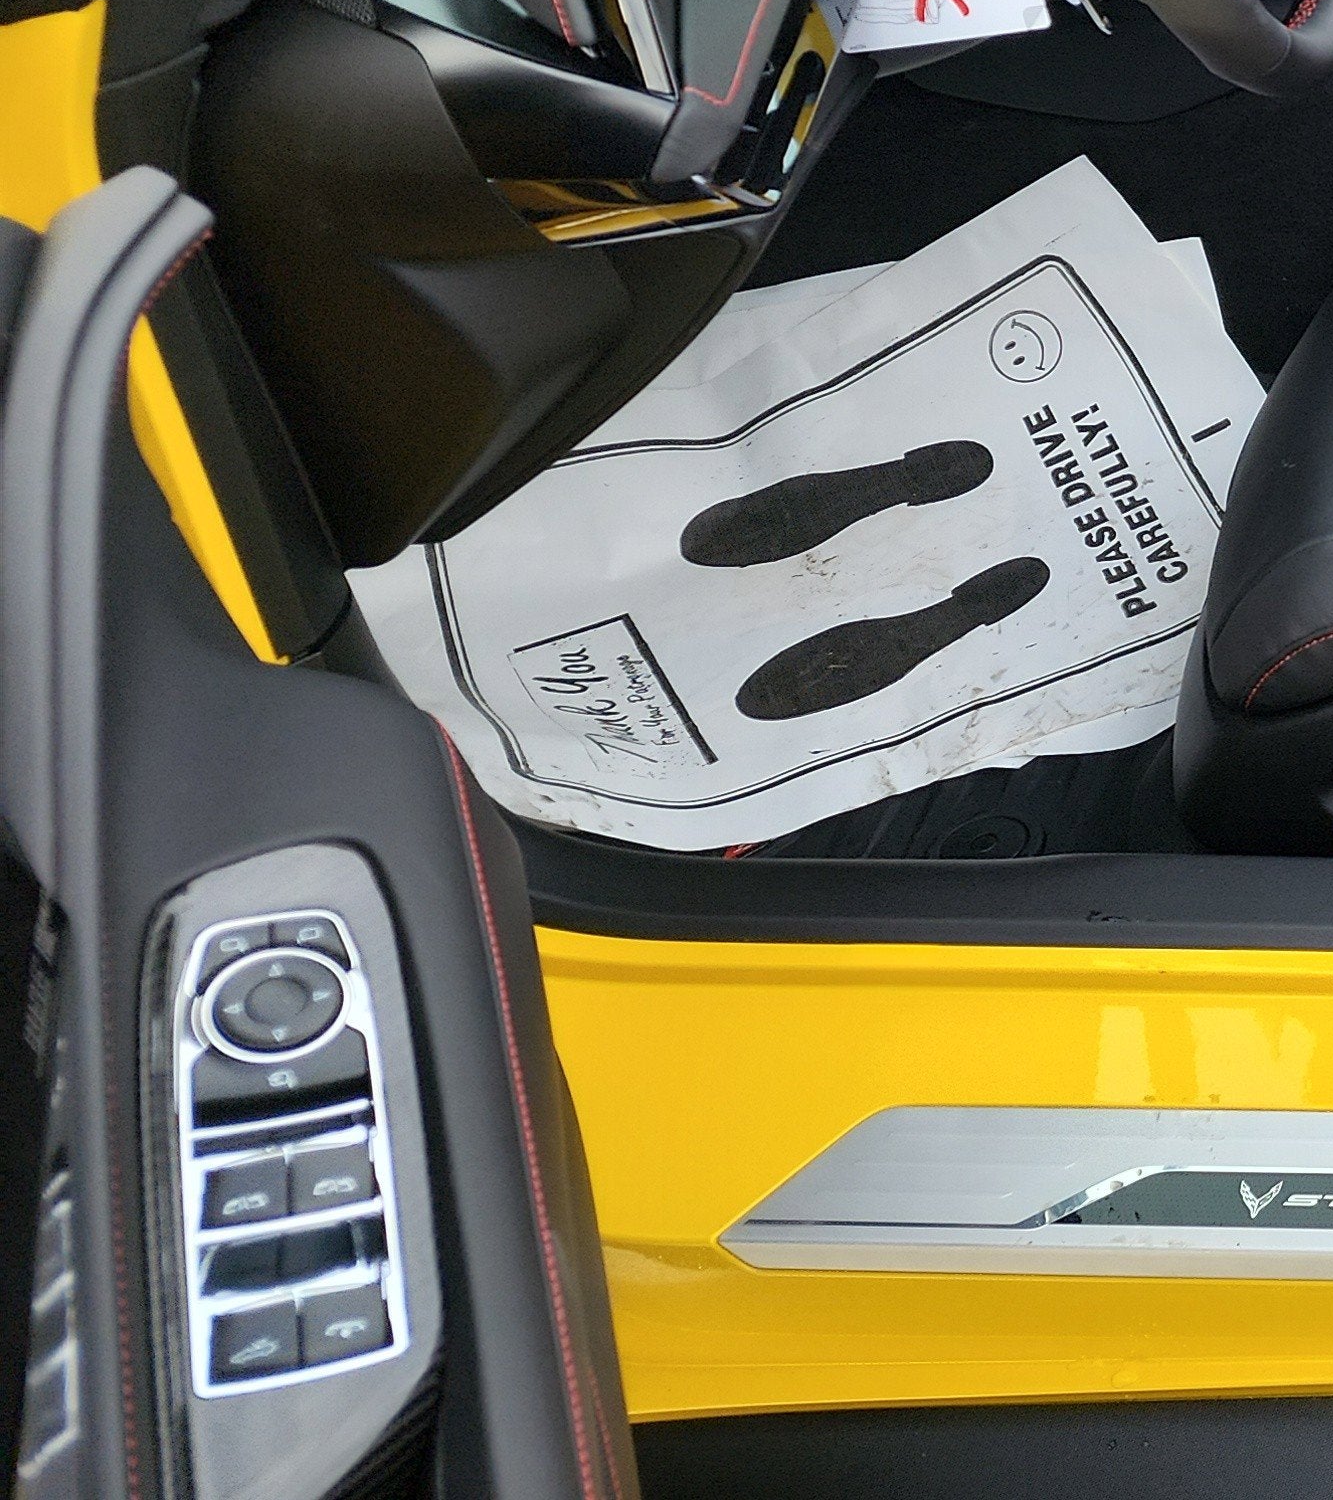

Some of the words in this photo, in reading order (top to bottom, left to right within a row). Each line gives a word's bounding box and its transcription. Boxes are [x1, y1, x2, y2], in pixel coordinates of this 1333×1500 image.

[1022, 404, 1096, 509] DRIVE
[1071, 403, 1189, 583] CAREFULLY!
[1073, 506, 1157, 619] PLEASE
[531, 646, 609, 695] You
